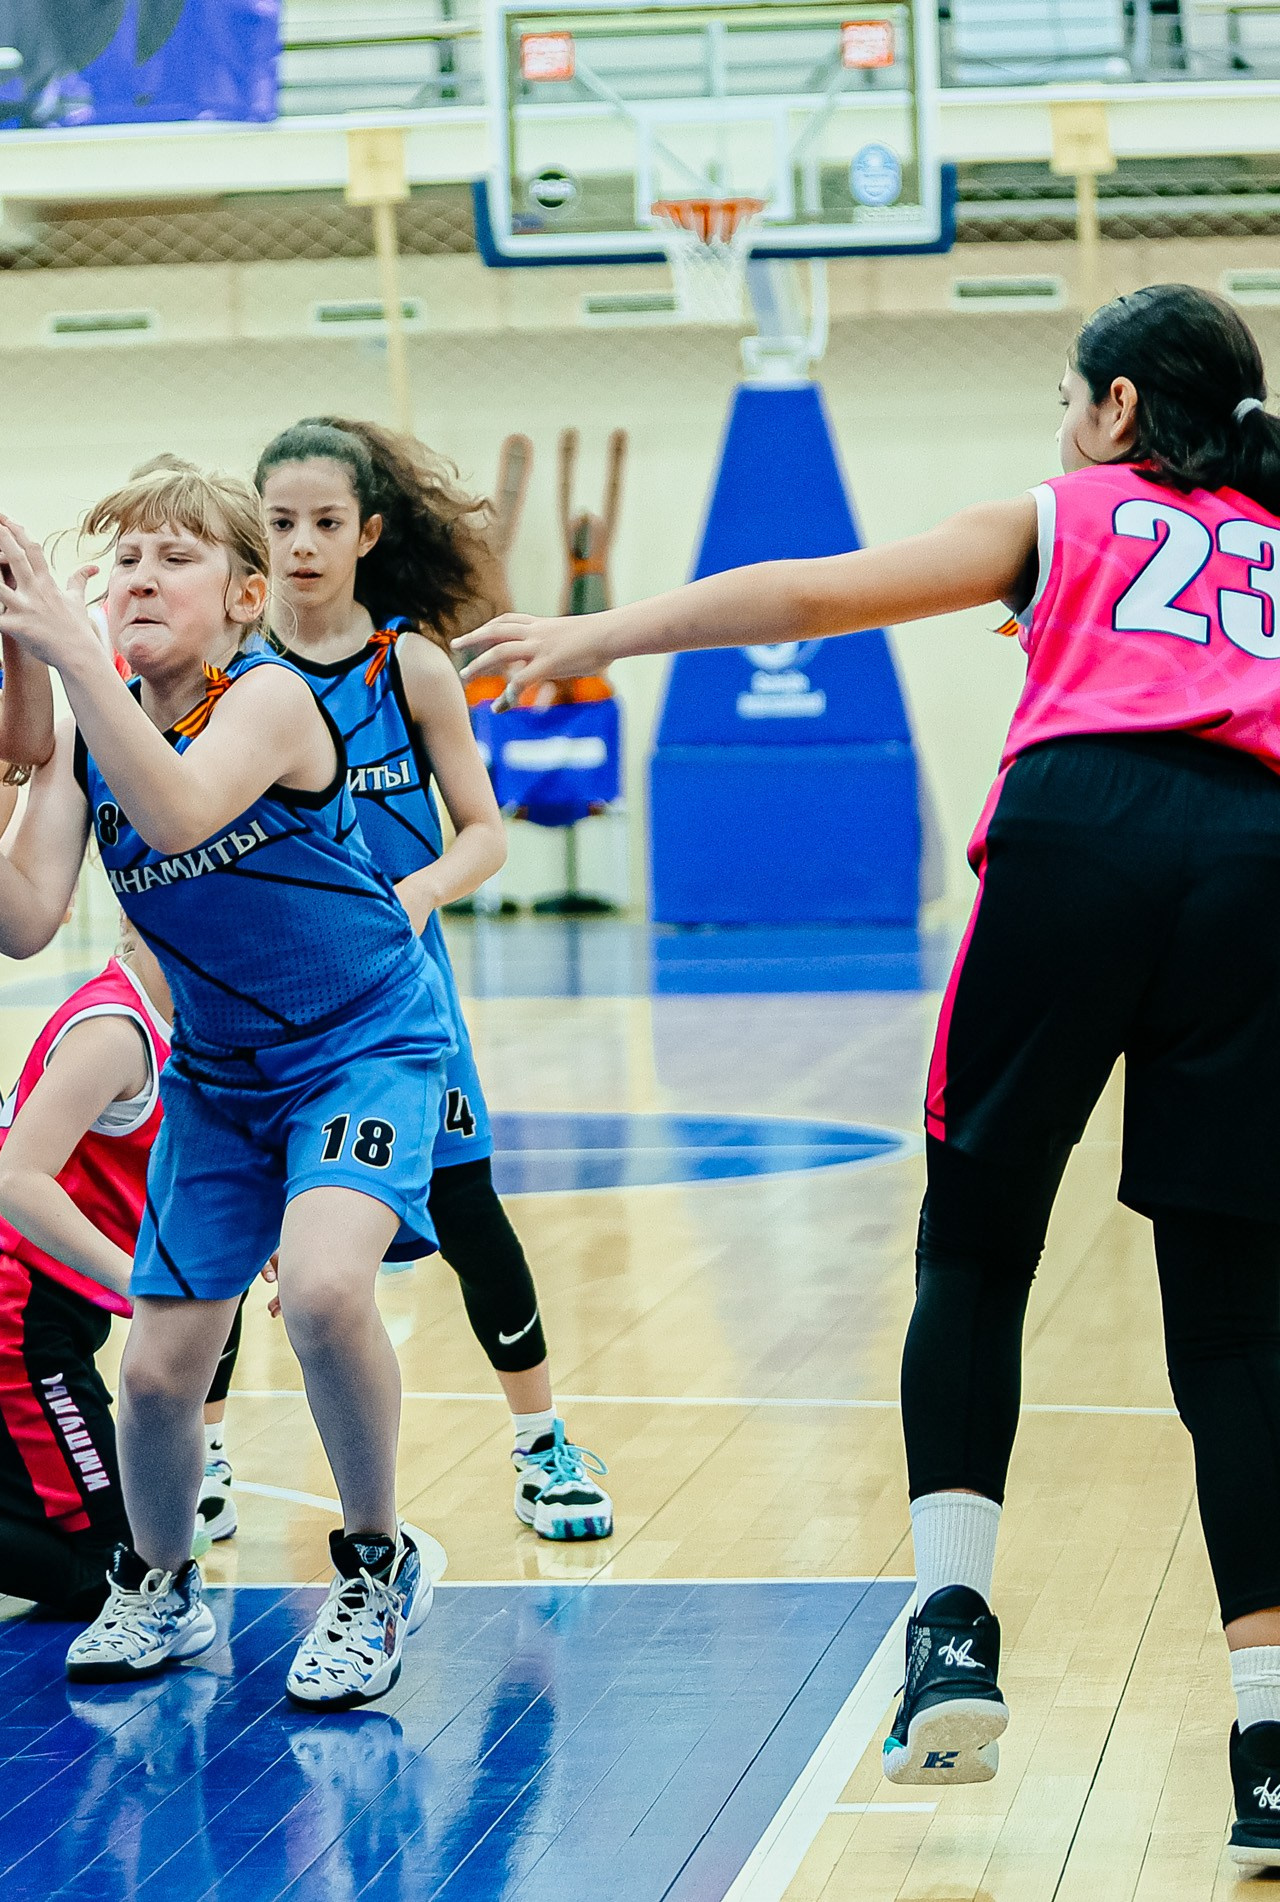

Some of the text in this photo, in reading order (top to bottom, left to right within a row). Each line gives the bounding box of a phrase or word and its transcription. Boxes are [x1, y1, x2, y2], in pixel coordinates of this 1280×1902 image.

[1112, 498, 1280, 660] 23
[97, 801, 119, 847] 8
[444, 1086, 476, 1139] 4
[320, 1113, 396, 1170] 18
